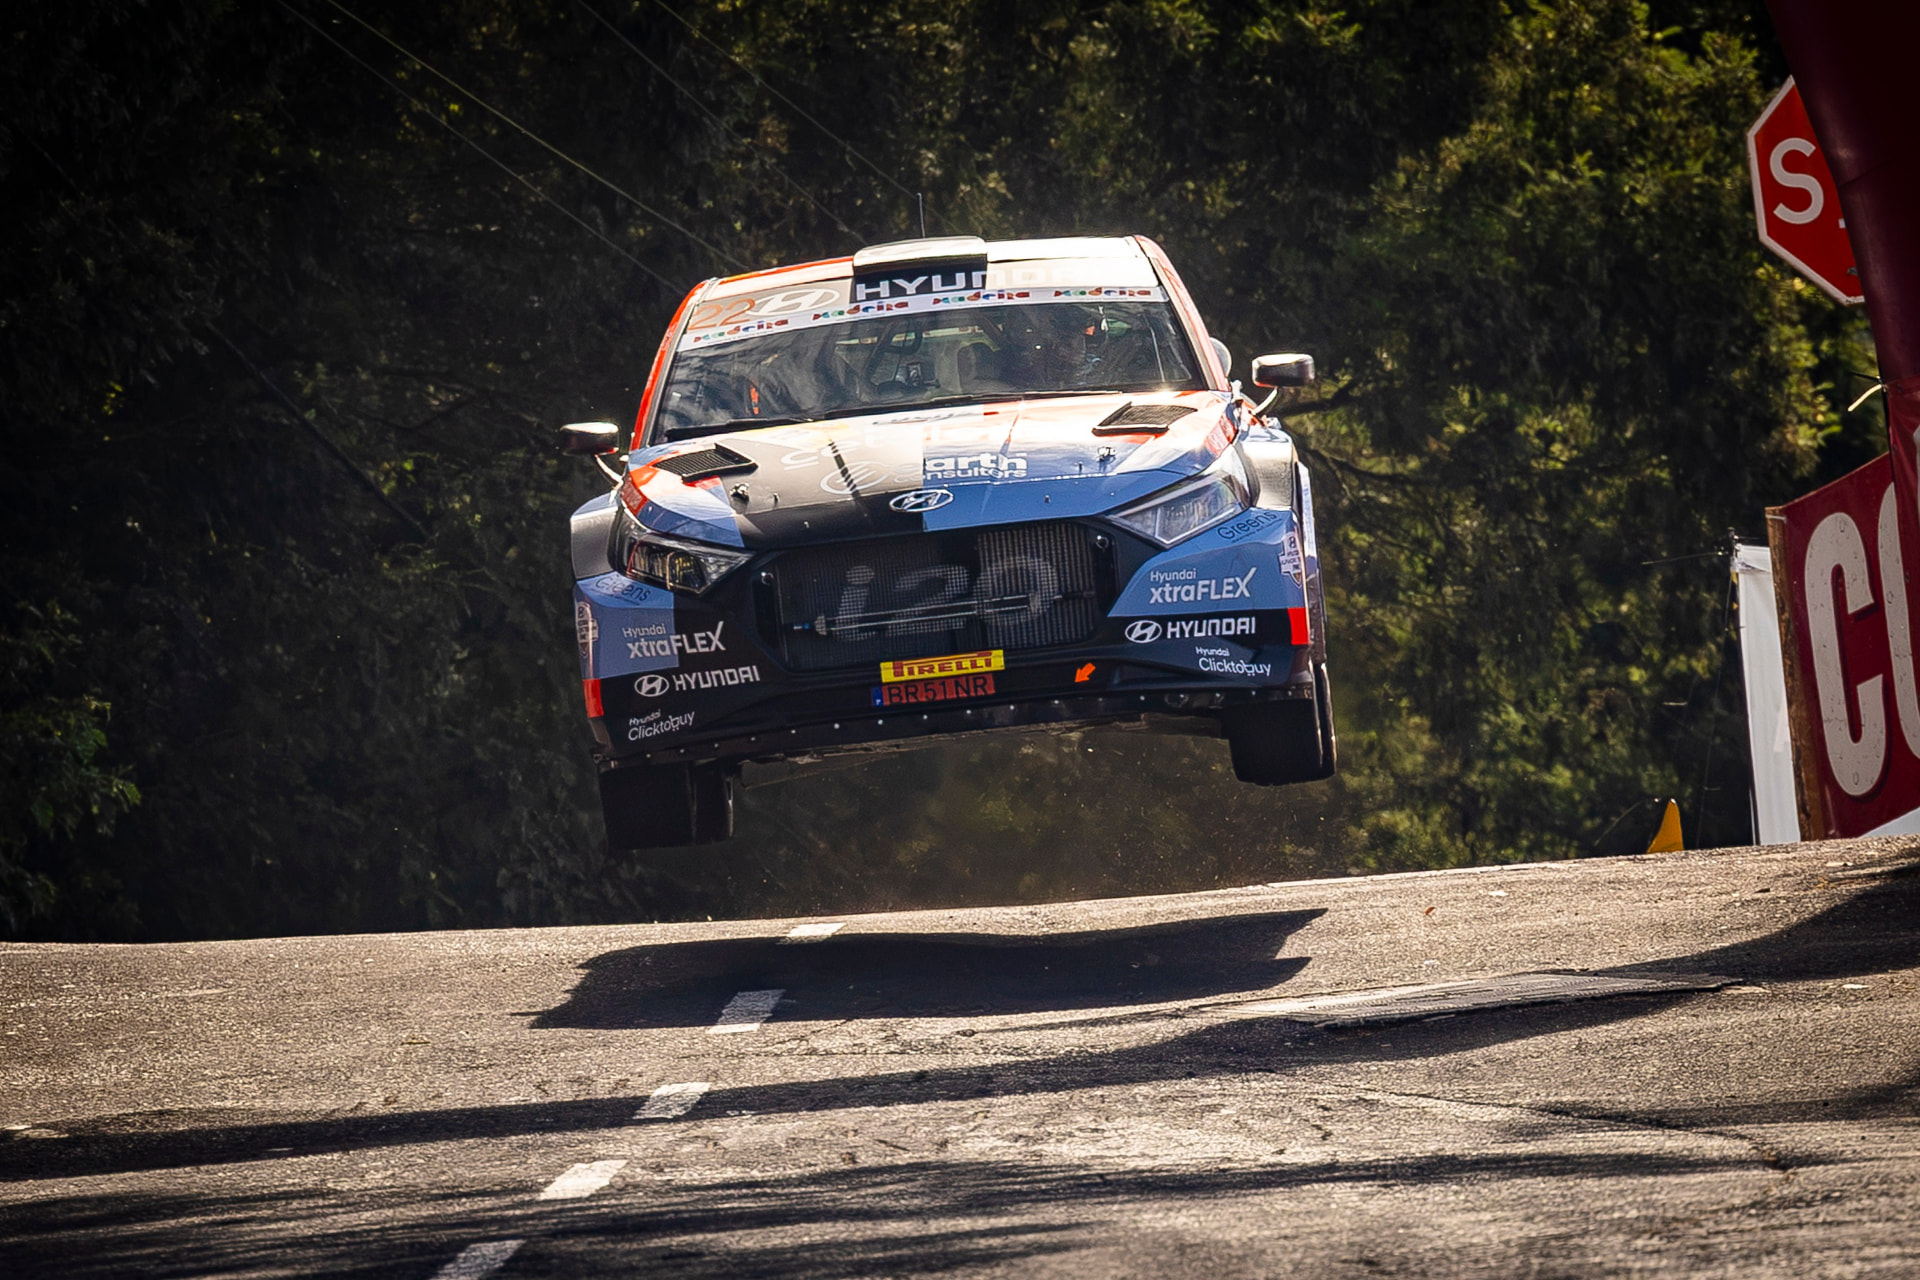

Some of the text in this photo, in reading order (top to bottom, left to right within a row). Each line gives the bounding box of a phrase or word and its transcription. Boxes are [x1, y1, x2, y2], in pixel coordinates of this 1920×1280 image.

[1769, 137, 1847, 229] S
[686, 297, 756, 331] 22
[1217, 511, 1278, 540] Greens
[595, 575, 652, 602] Greens
[1149, 566, 1257, 605] xtraFLEX
[1150, 567, 1197, 583] Hyundai
[831, 555, 1059, 642] i20
[621, 623, 667, 639] Hyundai
[626, 620, 727, 660] xtraFLEX
[1166, 616, 1256, 640] HYUNDAI
[892, 650, 994, 678] PIRELLI
[1195, 646, 1230, 657] Hyundai
[672, 664, 761, 692] HYUNDAI
[1198, 657, 1271, 677] Clicktobuy
[627, 711, 696, 742] Clicktobuy
[628, 708, 662, 727] Hyundai
